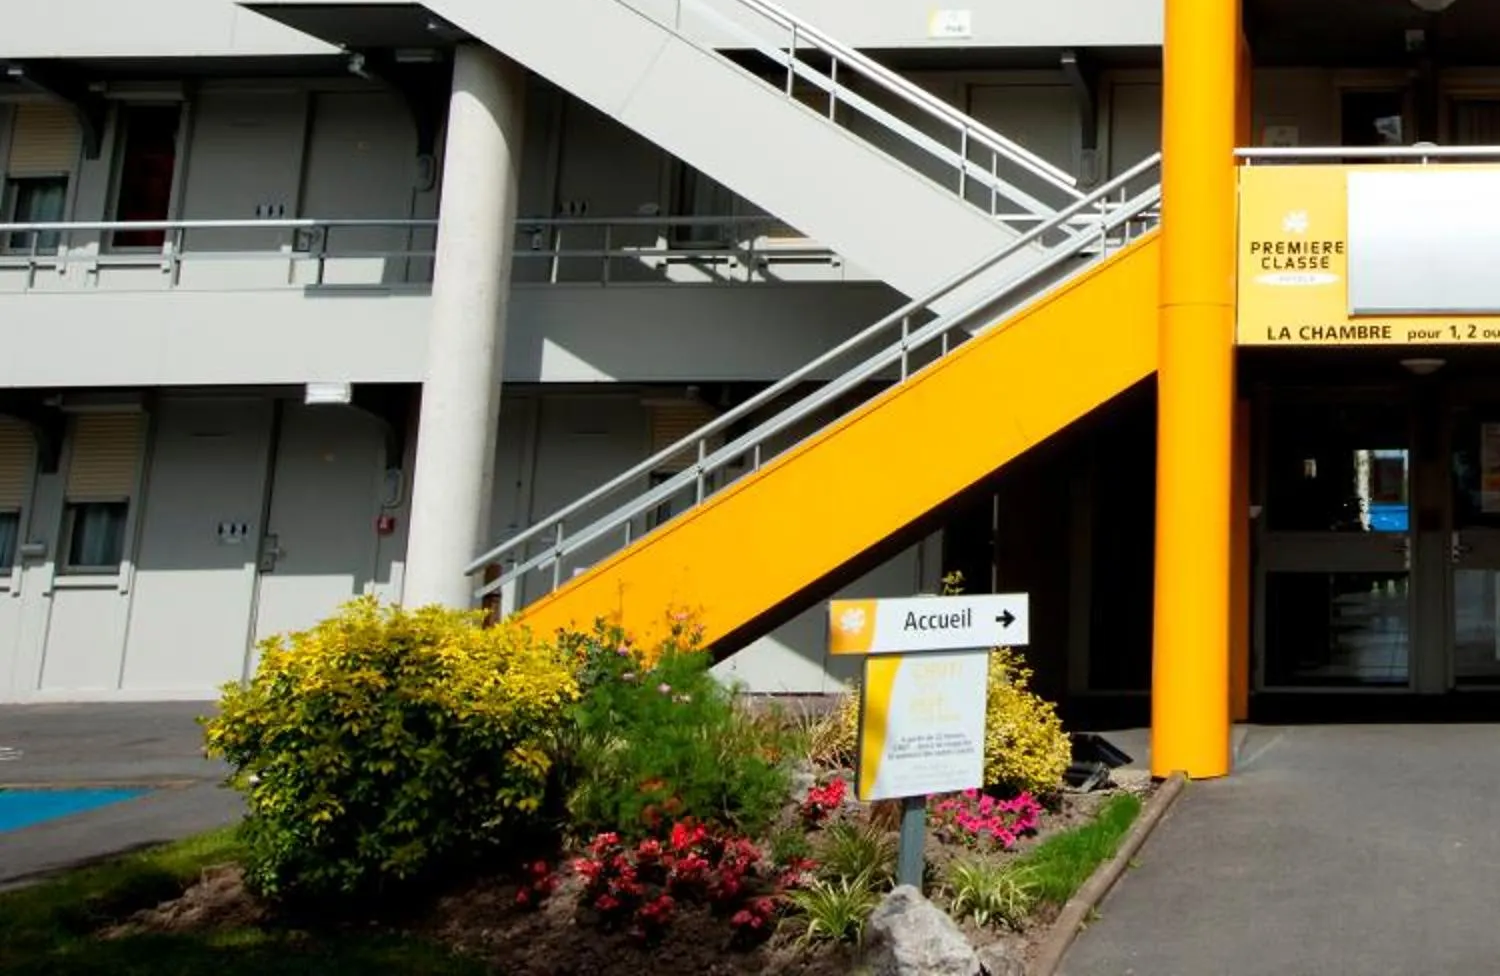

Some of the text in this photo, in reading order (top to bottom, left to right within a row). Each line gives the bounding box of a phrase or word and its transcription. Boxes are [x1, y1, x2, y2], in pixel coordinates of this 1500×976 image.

[1250, 241, 1345, 255] PREMIERE
[1261, 256, 1330, 270] CLASSE
[1266, 327, 1291, 341] LA
[1299, 325, 1392, 341] CHAMBRE
[1407, 328, 1442, 342] pour
[1449, 324, 1461, 340] 1,
[1466, 324, 1477, 339] 2
[1483, 328, 1500, 339] ou
[903, 607, 972, 631] Accueil
